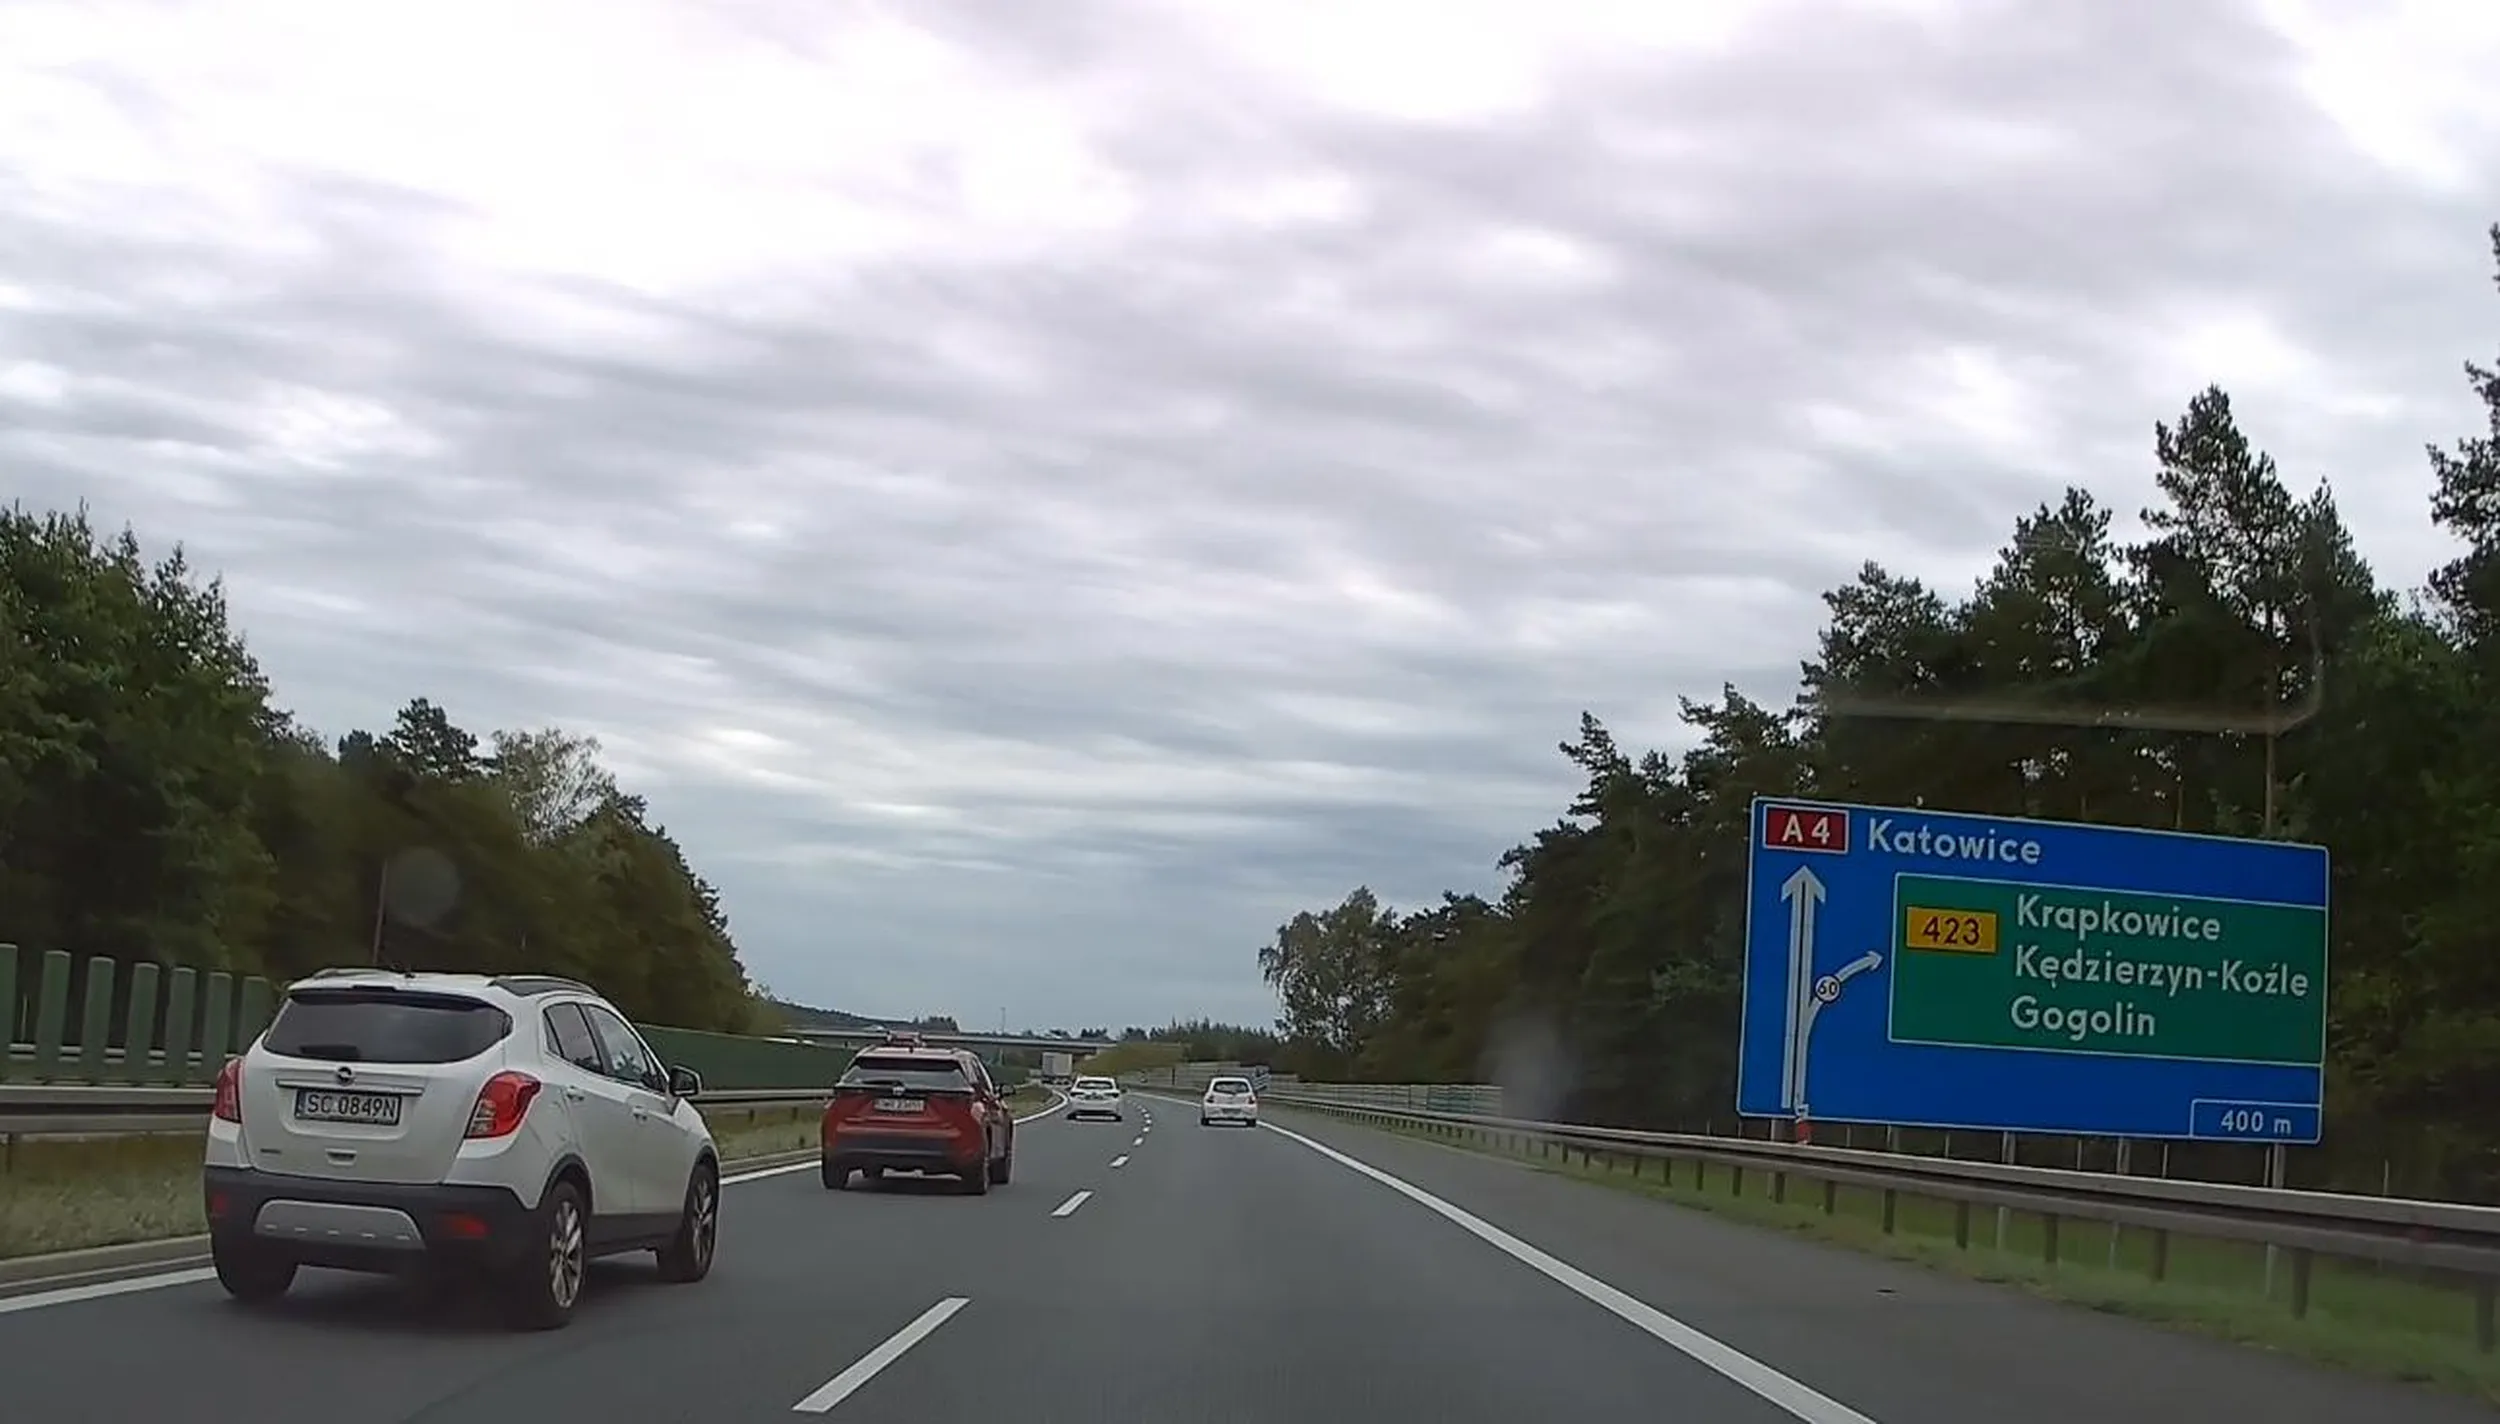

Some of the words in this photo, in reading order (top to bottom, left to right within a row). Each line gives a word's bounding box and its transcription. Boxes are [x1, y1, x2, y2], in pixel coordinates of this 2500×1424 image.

[1868, 817, 2042, 864] Katowice
[1922, 915, 1981, 946] 423
[2016, 894, 2221, 941] Krapkowice
[1817, 979, 1838, 996] 60
[2014, 944, 2309, 998] Kędzierzyn-Koźle
[2010, 995, 2156, 1041] Gogolin
[307, 1094, 333, 1114] SC
[338, 1095, 396, 1119] 0849N
[2220, 1109, 2264, 1133] 400
[2273, 1118, 2292, 1135] m
